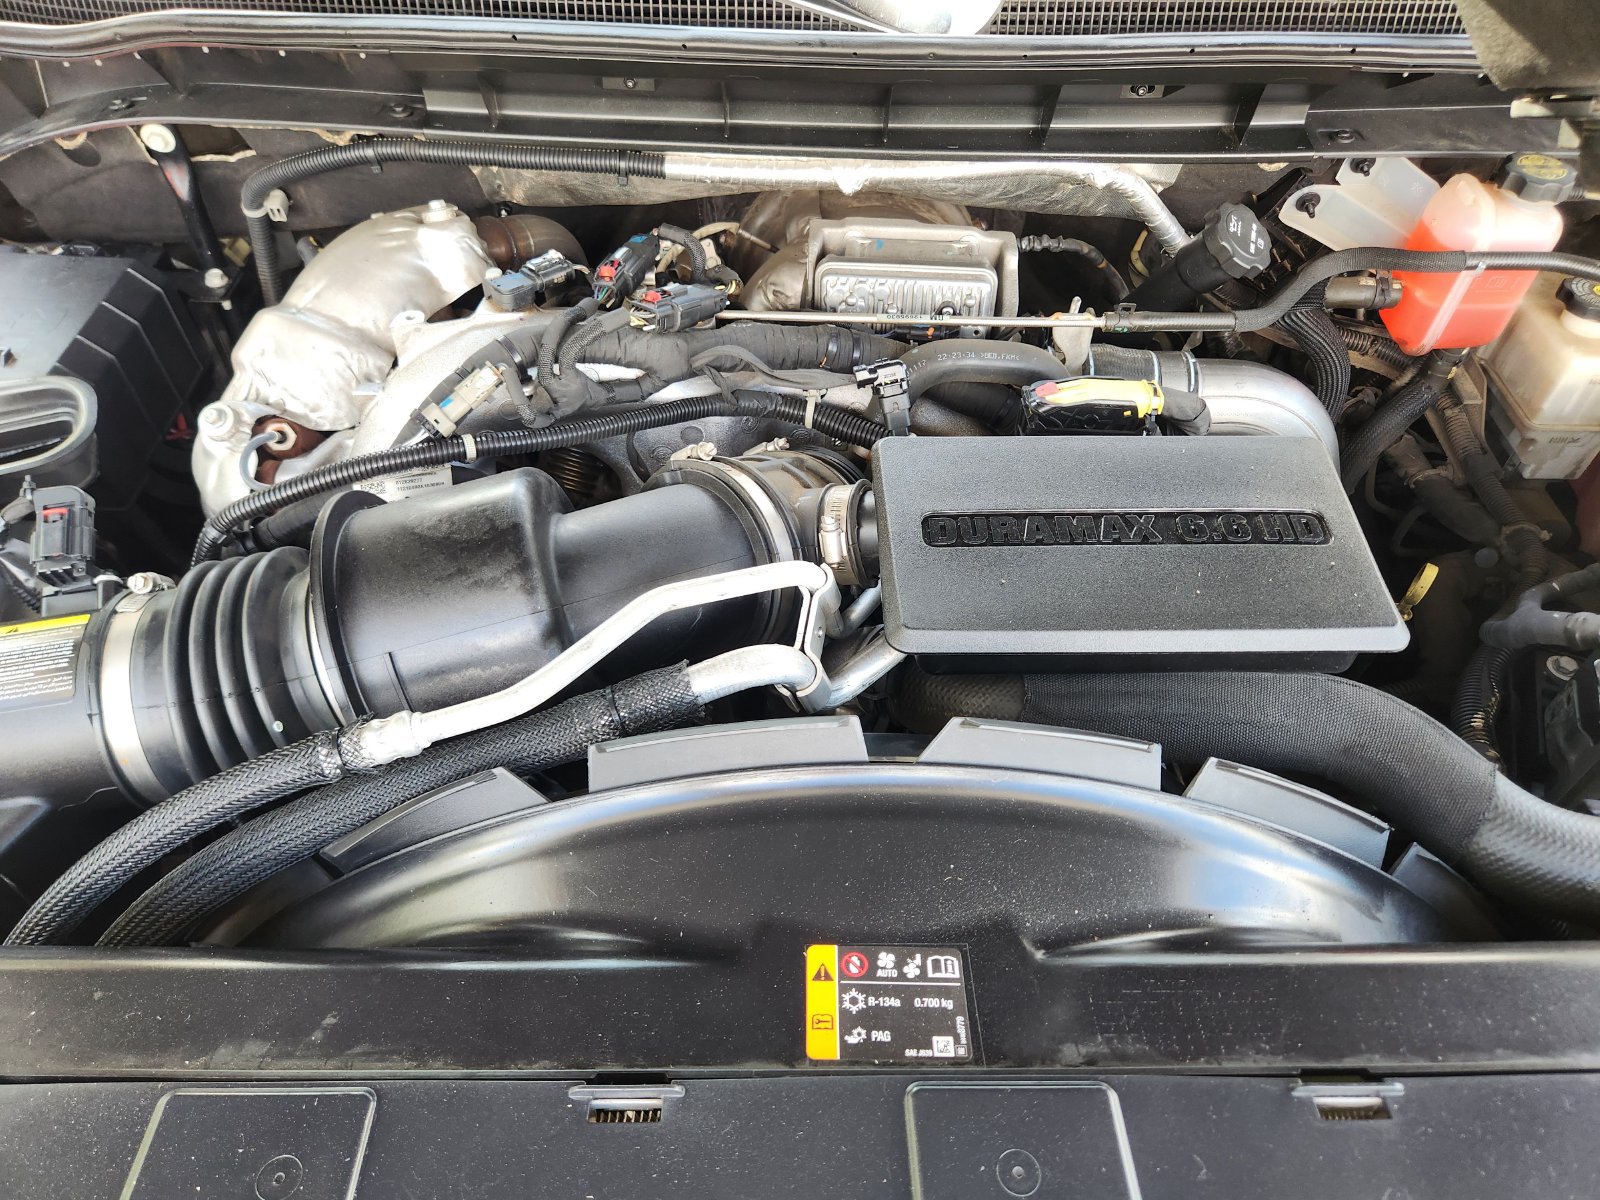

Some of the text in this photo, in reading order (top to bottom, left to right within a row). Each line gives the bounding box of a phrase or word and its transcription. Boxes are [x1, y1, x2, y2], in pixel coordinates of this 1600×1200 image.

[928, 514, 1325, 544] DURAMAX 6.6 HD
[876, 969, 898, 977] AUTO
[868, 996, 954, 1009] R-134a 0.700 kg
[871, 1030, 891, 1042] PAG
